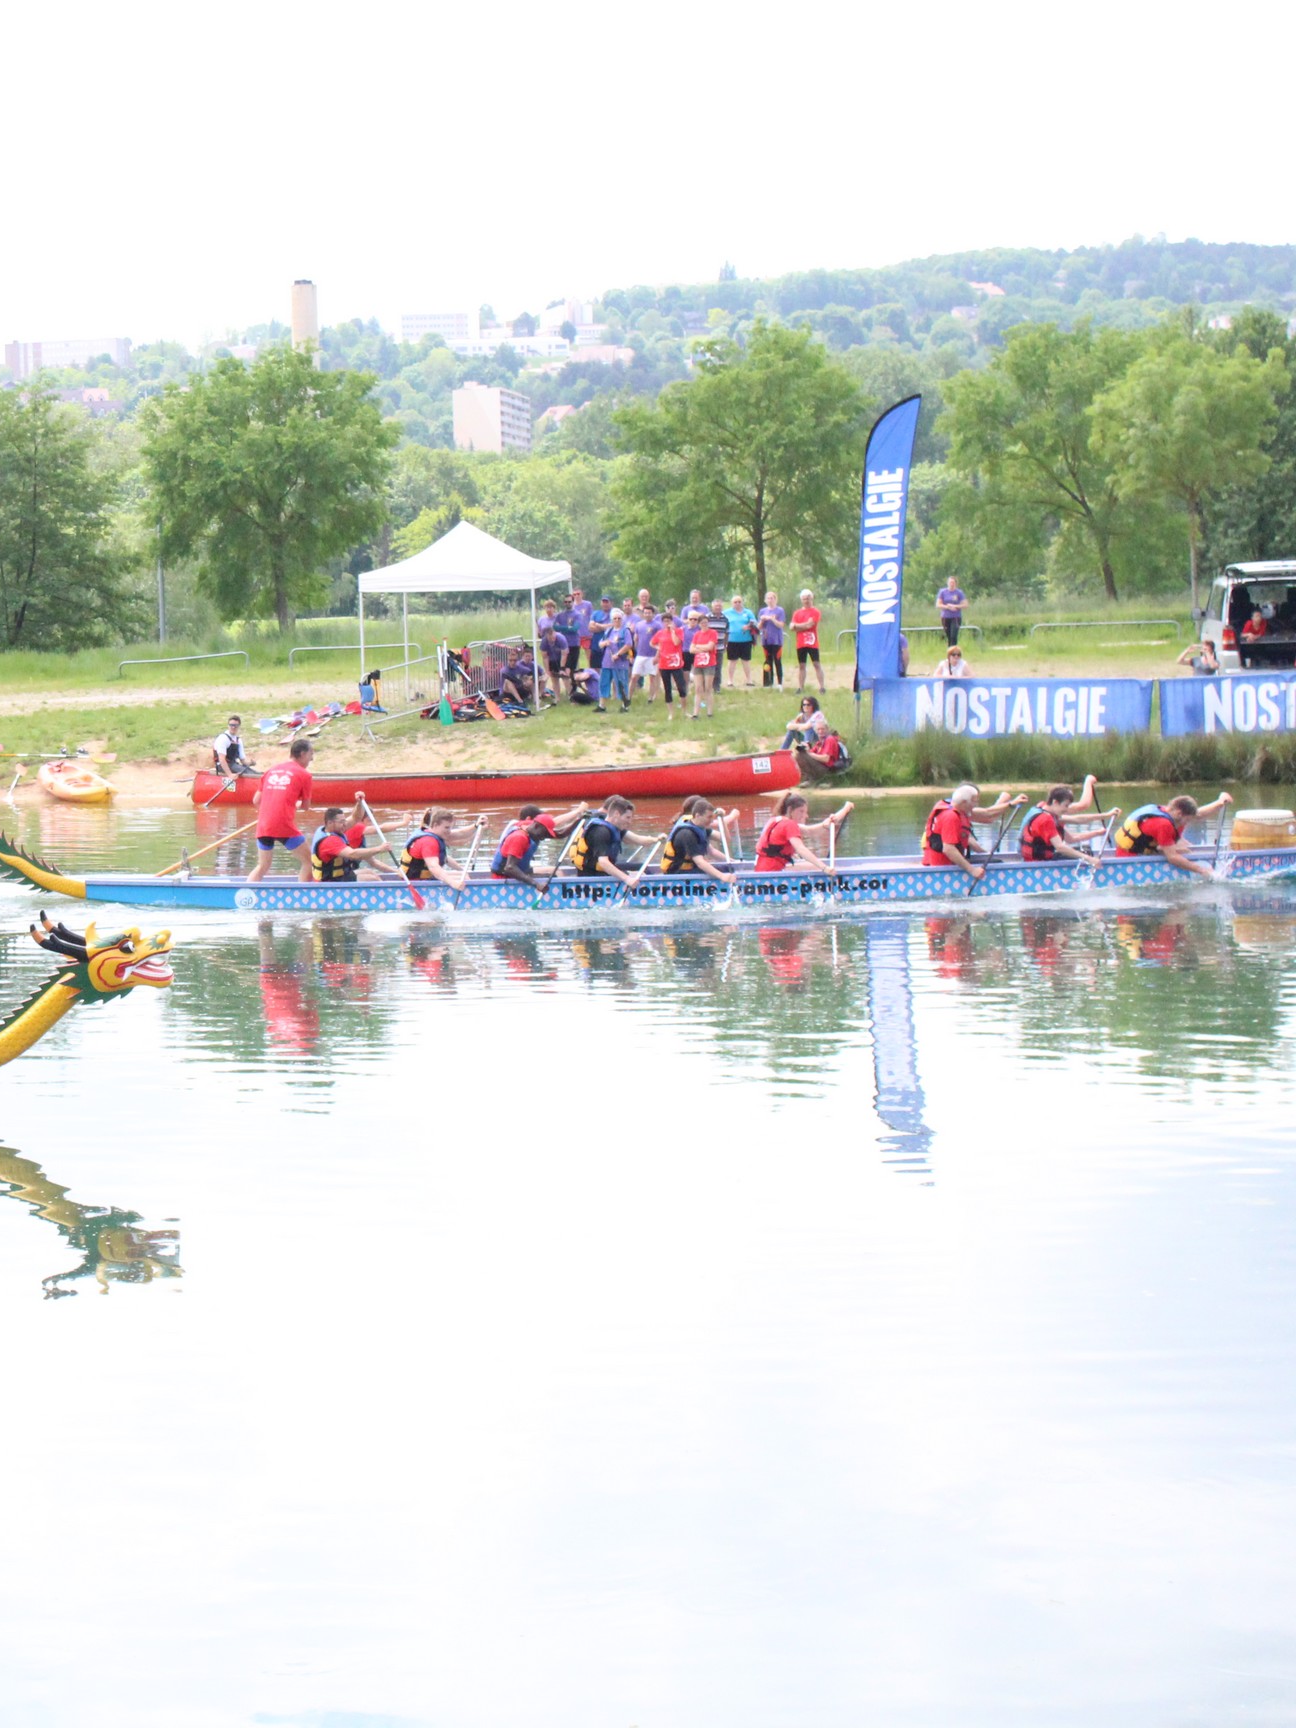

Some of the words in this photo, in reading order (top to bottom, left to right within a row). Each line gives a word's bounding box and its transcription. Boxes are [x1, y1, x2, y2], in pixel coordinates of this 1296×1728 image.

[859, 467, 904, 625] NOSTALGIE
[915, 680, 1107, 736] NOSTALGIE
[1204, 678, 1296, 735] NOST
